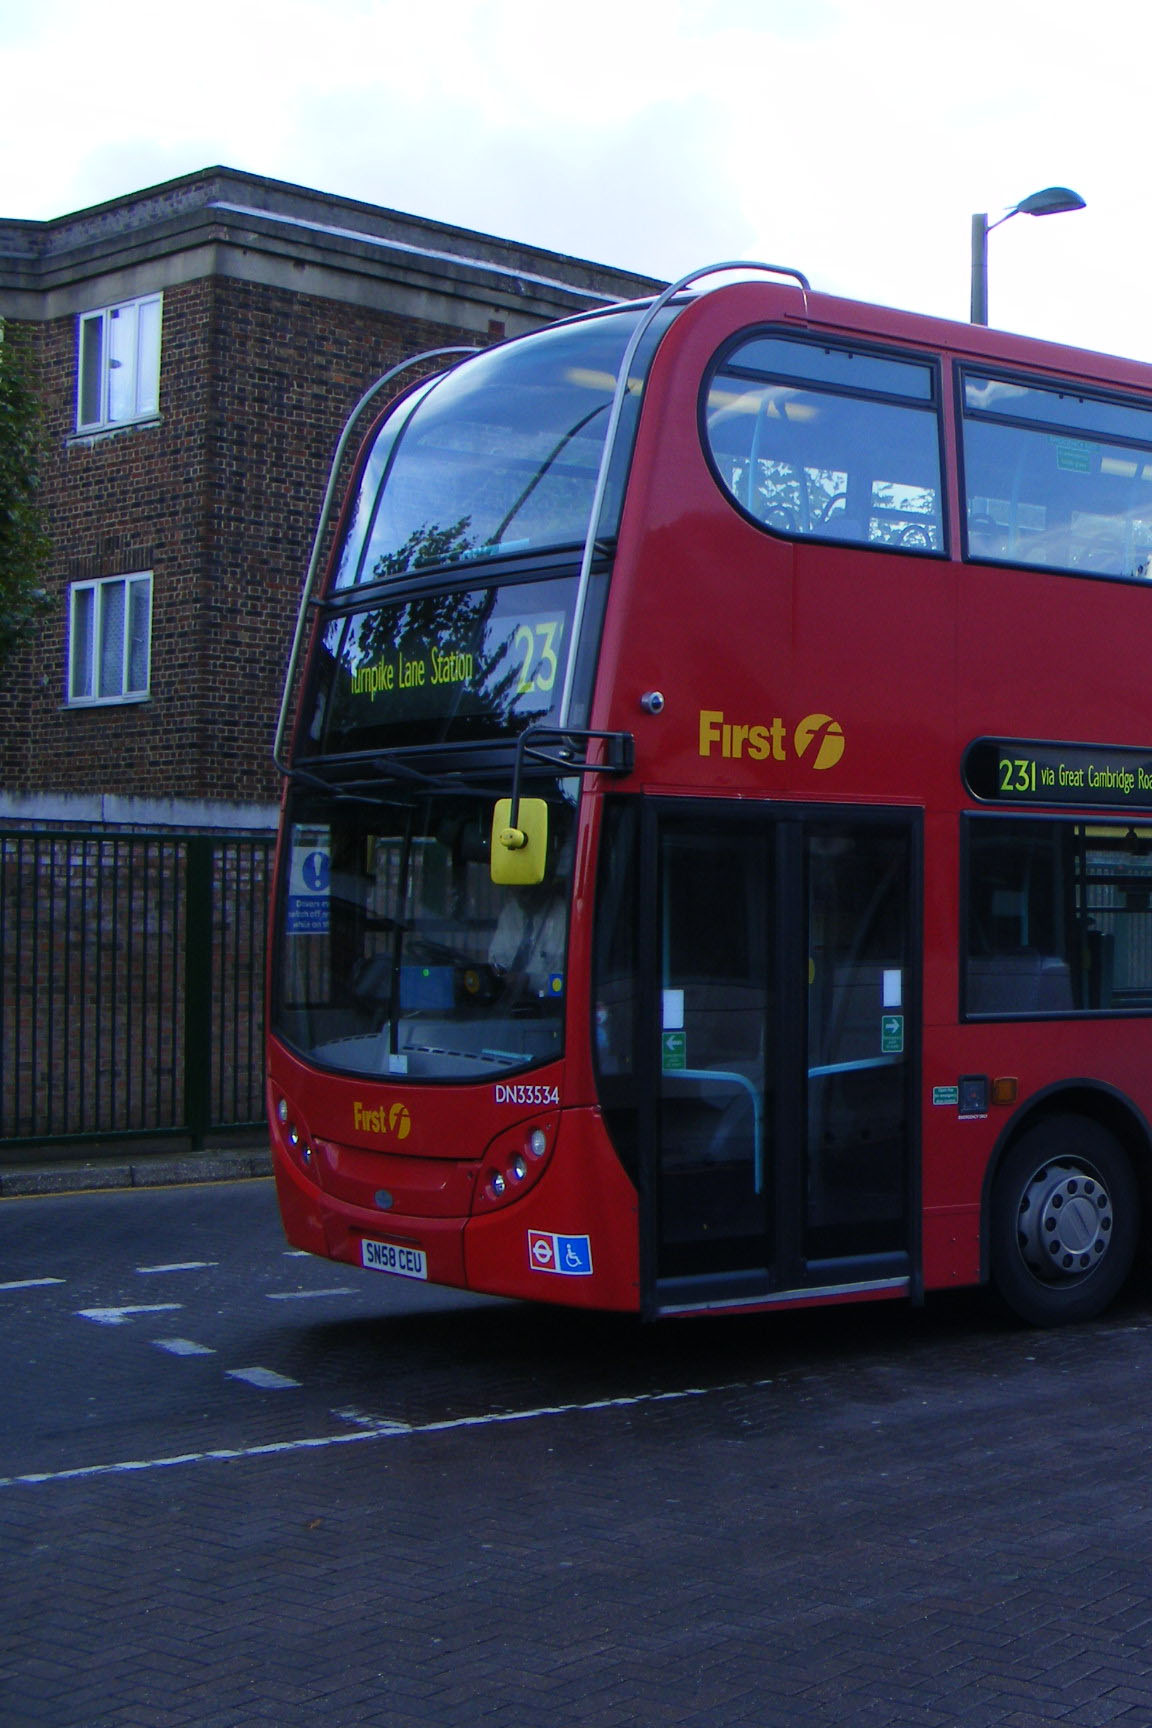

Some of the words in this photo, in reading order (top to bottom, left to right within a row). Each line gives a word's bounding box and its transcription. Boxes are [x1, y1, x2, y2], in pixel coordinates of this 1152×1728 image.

[399, 652, 425, 688] Lane
[431, 645, 473, 684] Station
[514, 620, 564, 694] 23
[700, 710, 786, 760] First
[1000, 759, 1036, 791] 231
[1041, 767, 1055, 786] via
[1059, 764, 1084, 788] Great
[1088, 765, 1135, 794] Cambridge
[495, 1084, 560, 1105] DN33534
[353, 1102, 387, 1133] First
[366, 1242, 396, 1269] SN58
[398, 1249, 423, 1273] CEU
